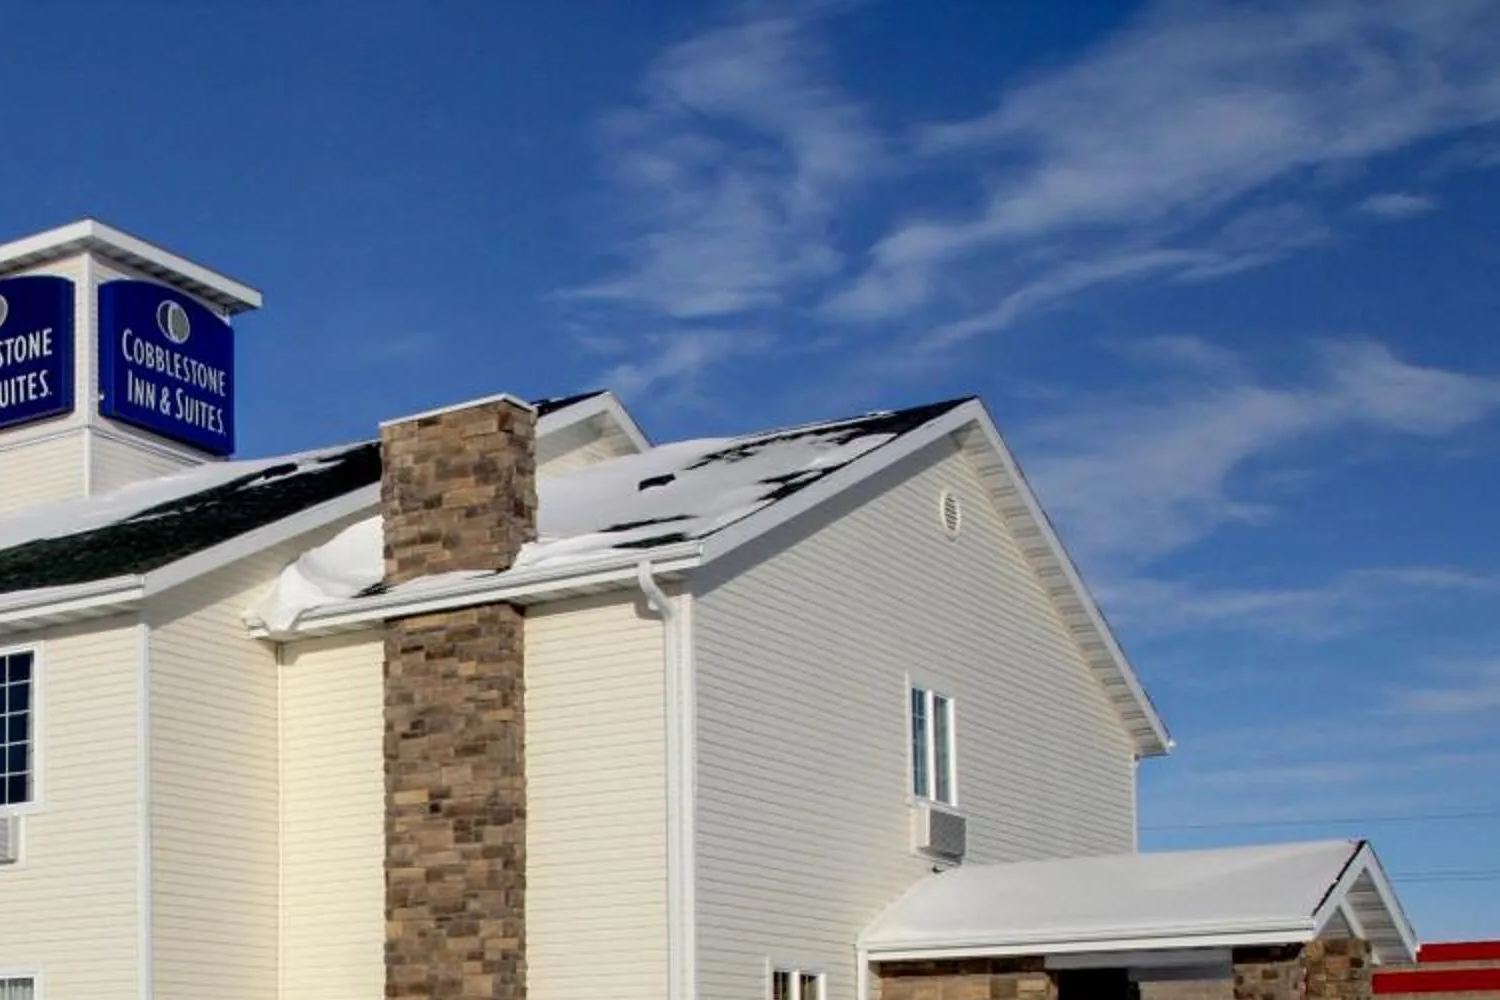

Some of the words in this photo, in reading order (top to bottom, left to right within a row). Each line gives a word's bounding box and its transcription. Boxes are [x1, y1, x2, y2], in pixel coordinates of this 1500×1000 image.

[122, 327, 227, 397] COBBLESTONE
[127, 369, 156, 411] INN
[160, 386, 171, 416] &
[175, 387, 224, 434] SUITES
